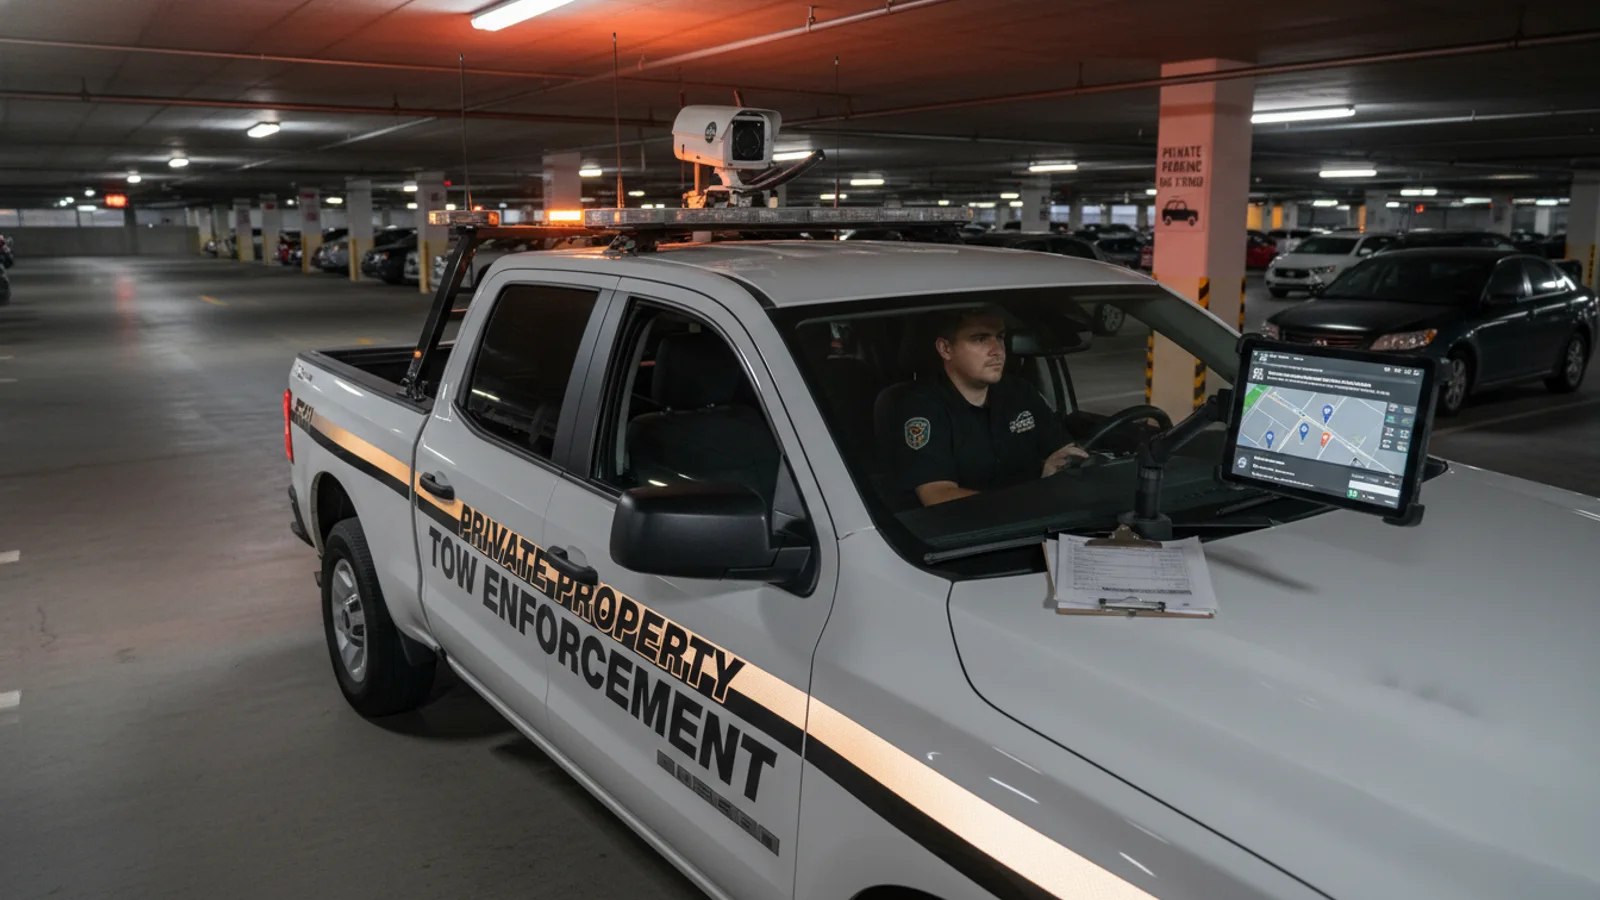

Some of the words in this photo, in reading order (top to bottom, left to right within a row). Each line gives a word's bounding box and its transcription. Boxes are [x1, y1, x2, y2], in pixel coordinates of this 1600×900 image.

[429, 525, 478, 596] TOW
[482, 564, 778, 803] ENFORCEMENT
[458, 503, 548, 593] PRIVATE
[554, 570, 745, 704] PROPERTY
